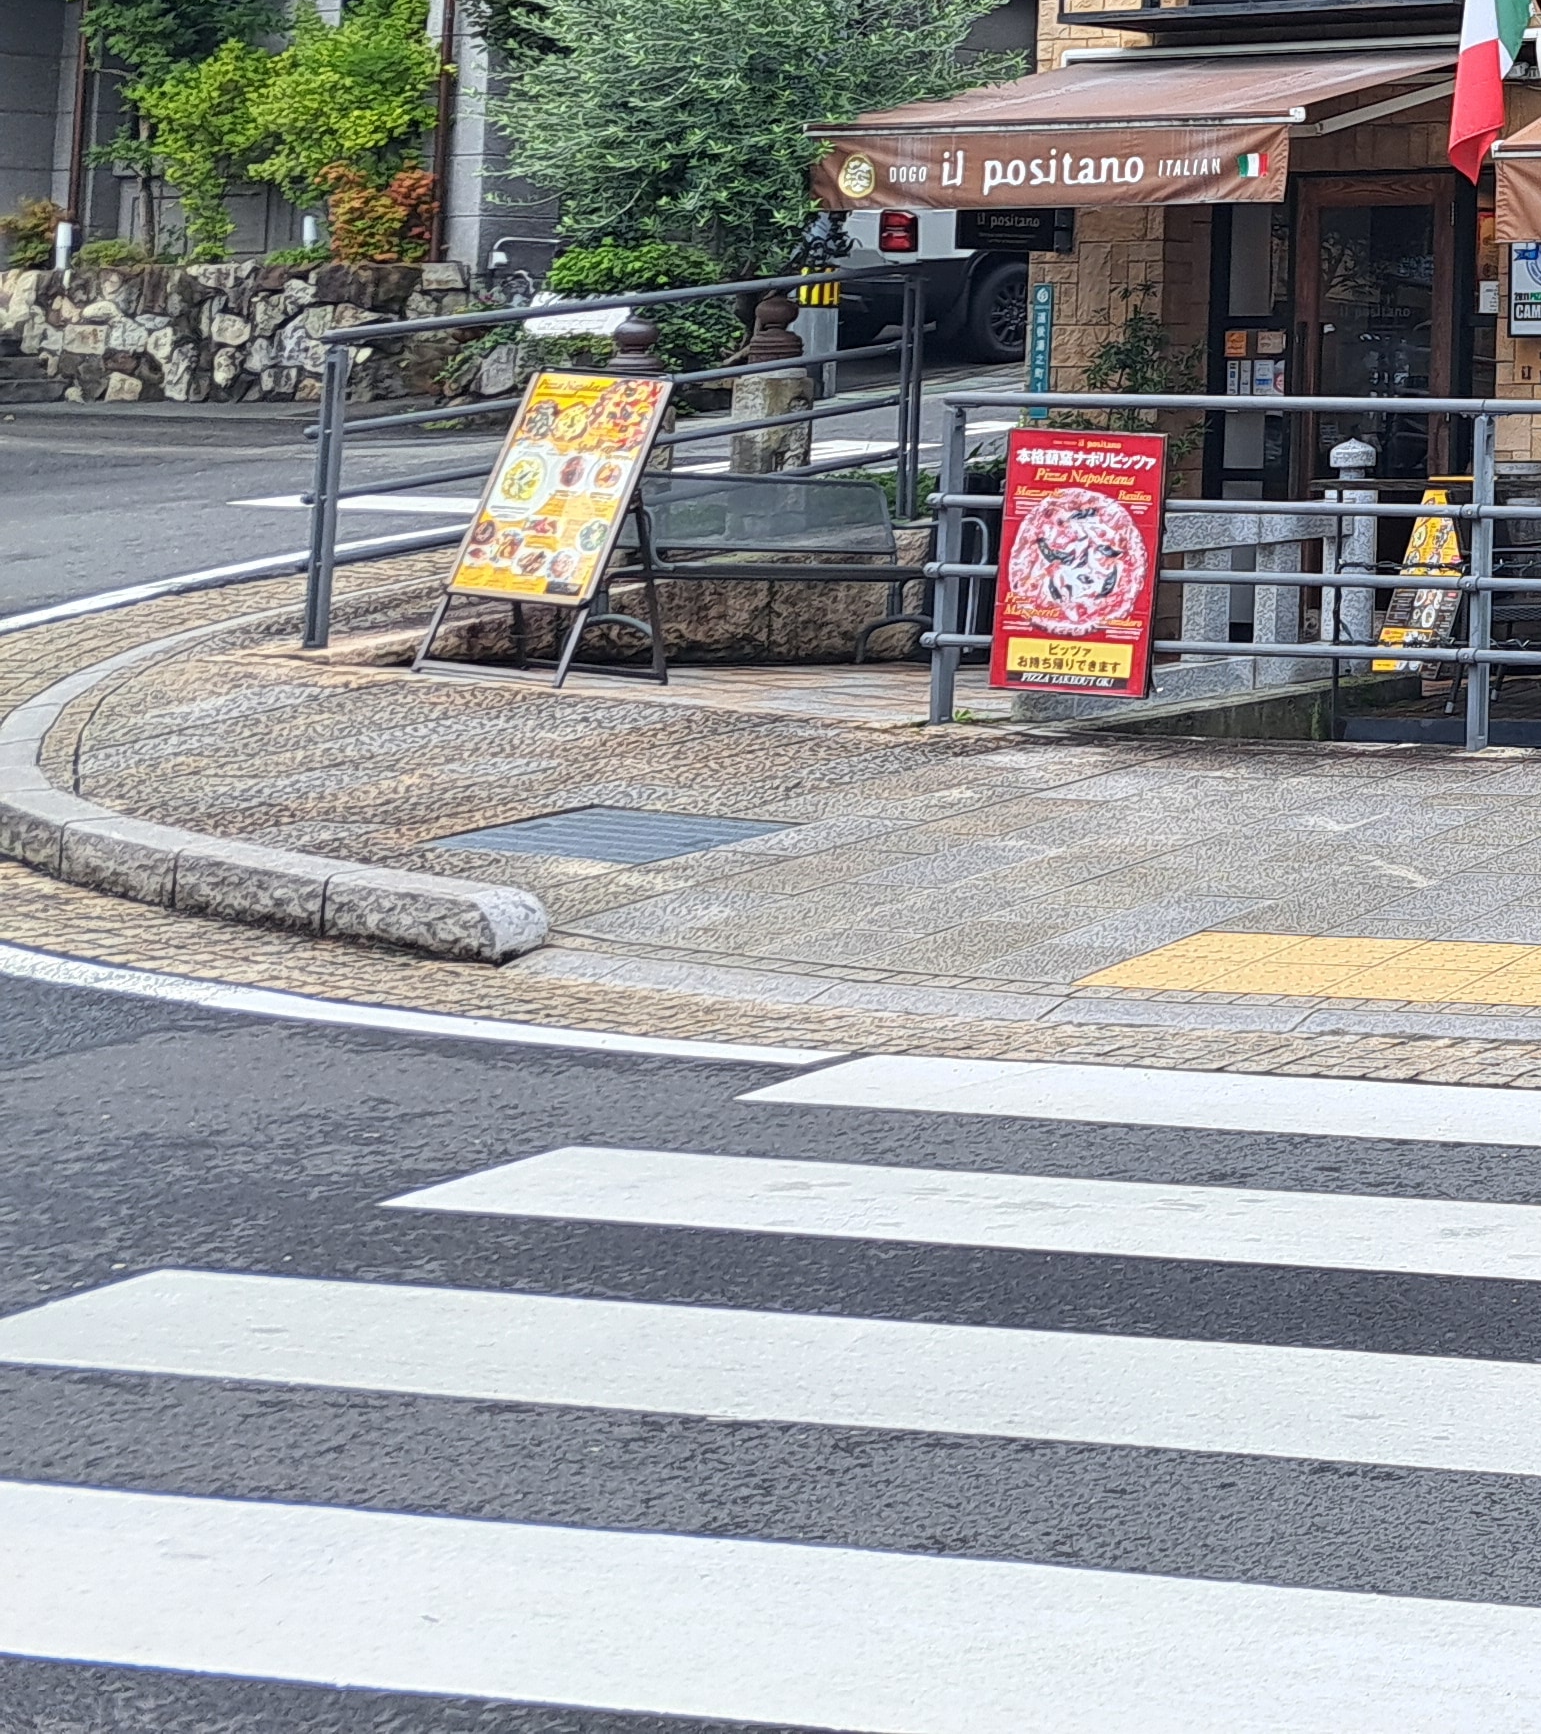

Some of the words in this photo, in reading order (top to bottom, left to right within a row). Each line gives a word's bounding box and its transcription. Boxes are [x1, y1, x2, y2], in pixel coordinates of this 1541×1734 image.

[889, 165, 927, 183] DOGO
[941, 150, 964, 187] il
[983, 148, 1145, 196] positano
[1158, 157, 1221, 178] ITALIAN
[990, 214, 1040, 229] positano
